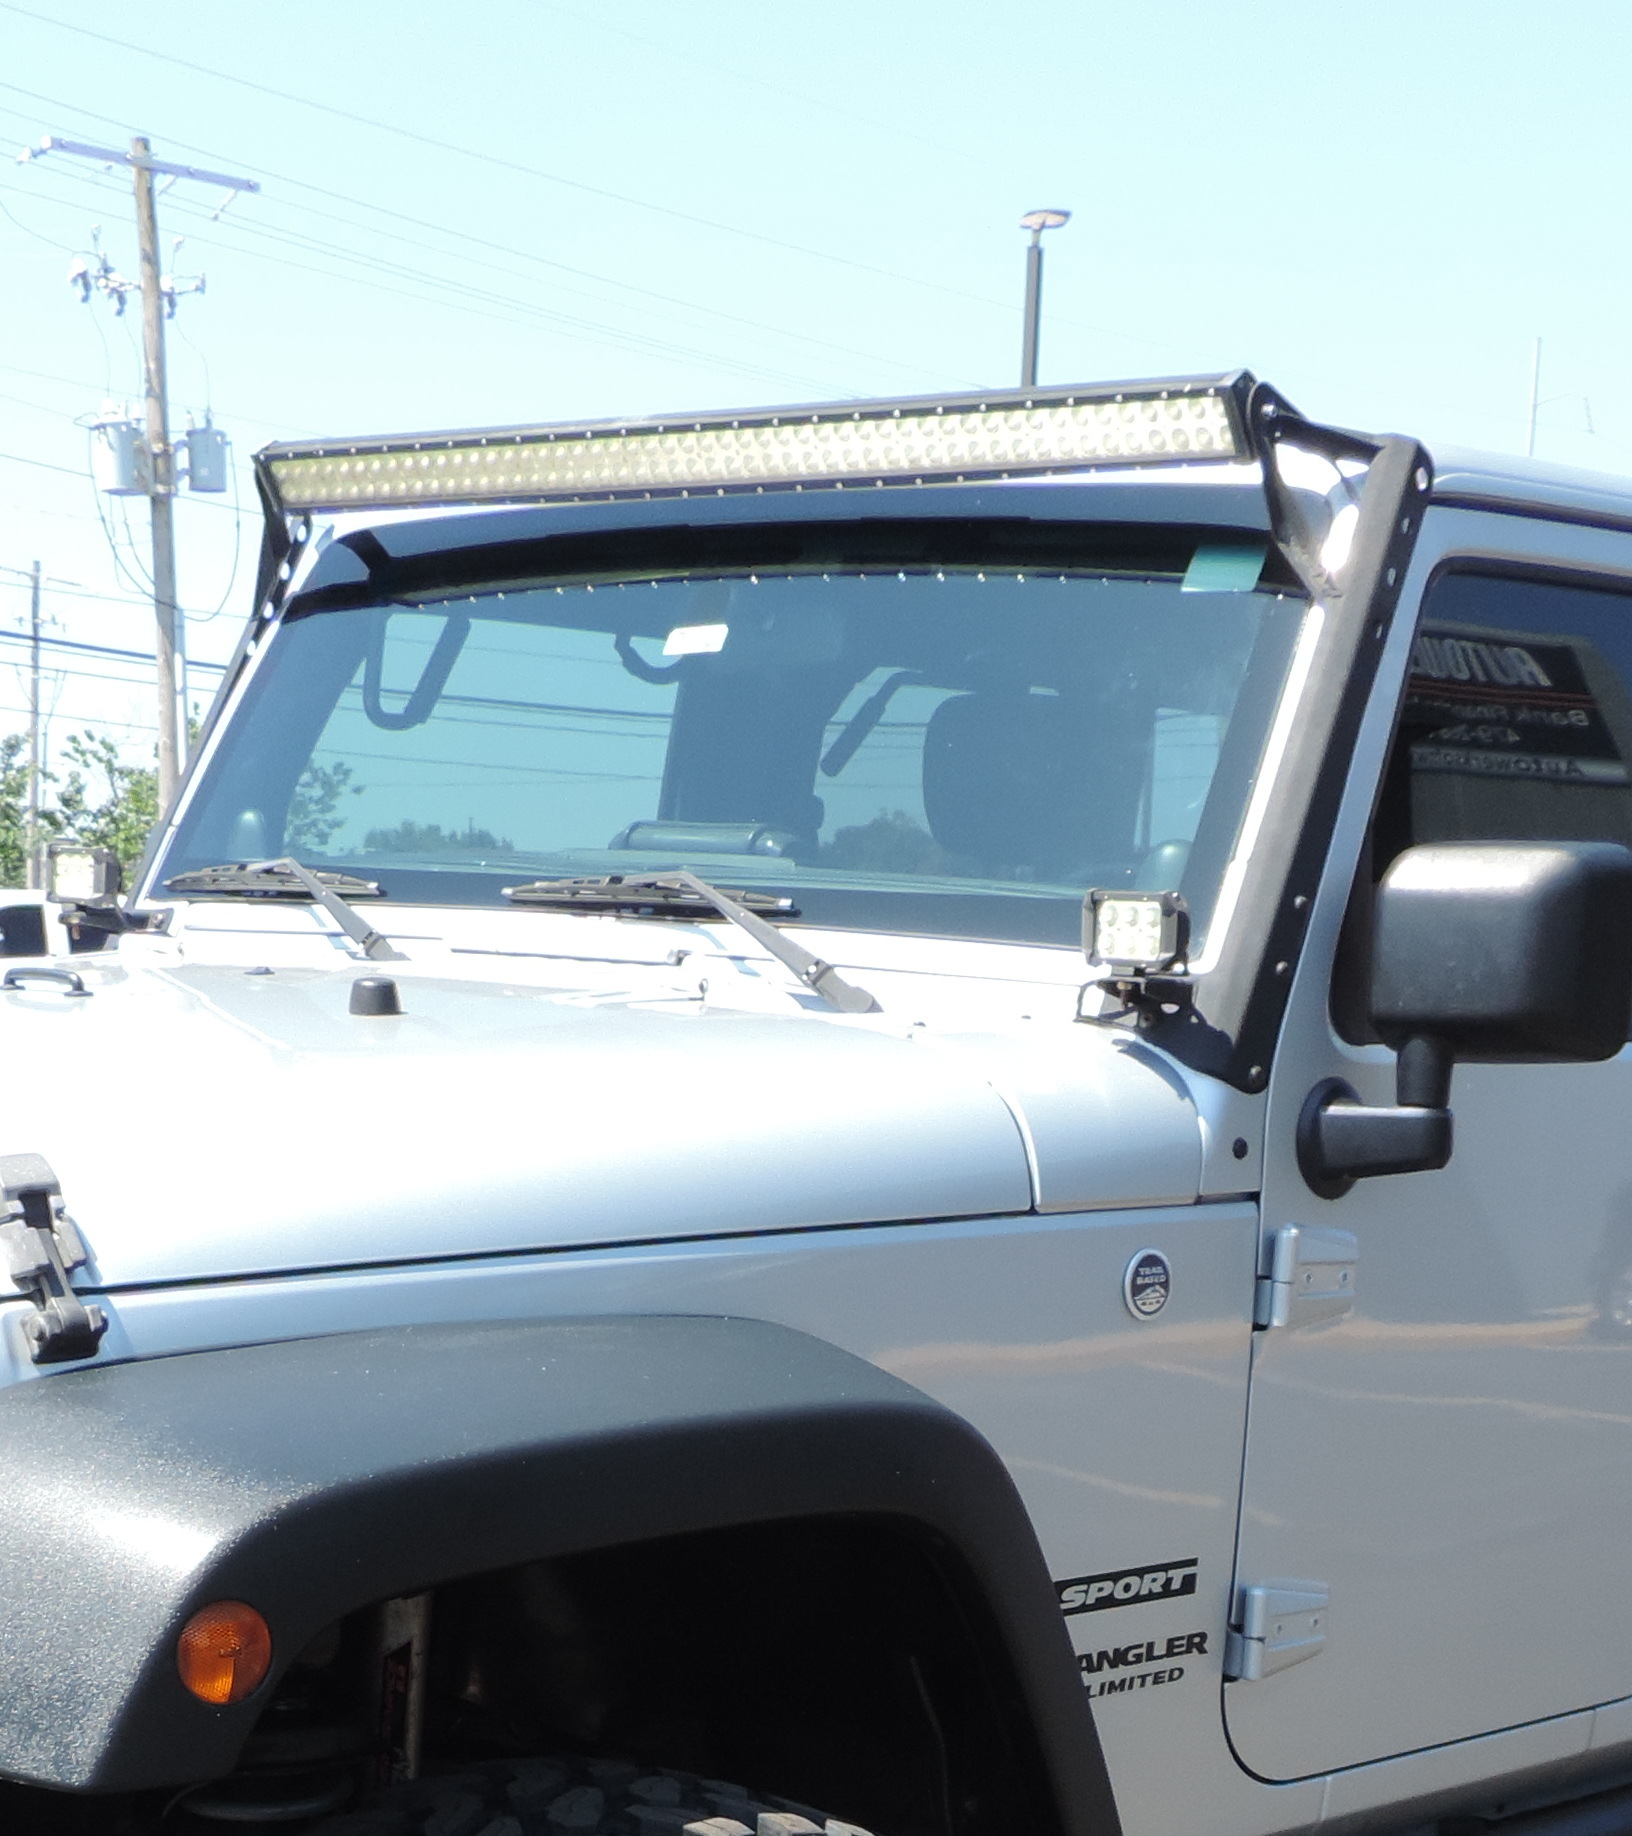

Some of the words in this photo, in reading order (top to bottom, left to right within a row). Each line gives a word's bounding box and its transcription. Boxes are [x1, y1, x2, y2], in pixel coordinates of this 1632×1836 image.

[1060, 1566, 1198, 1610] SPORT
[1076, 1631, 1209, 1675] ANGLER
[1086, 1667, 1185, 1699] LIMITED
